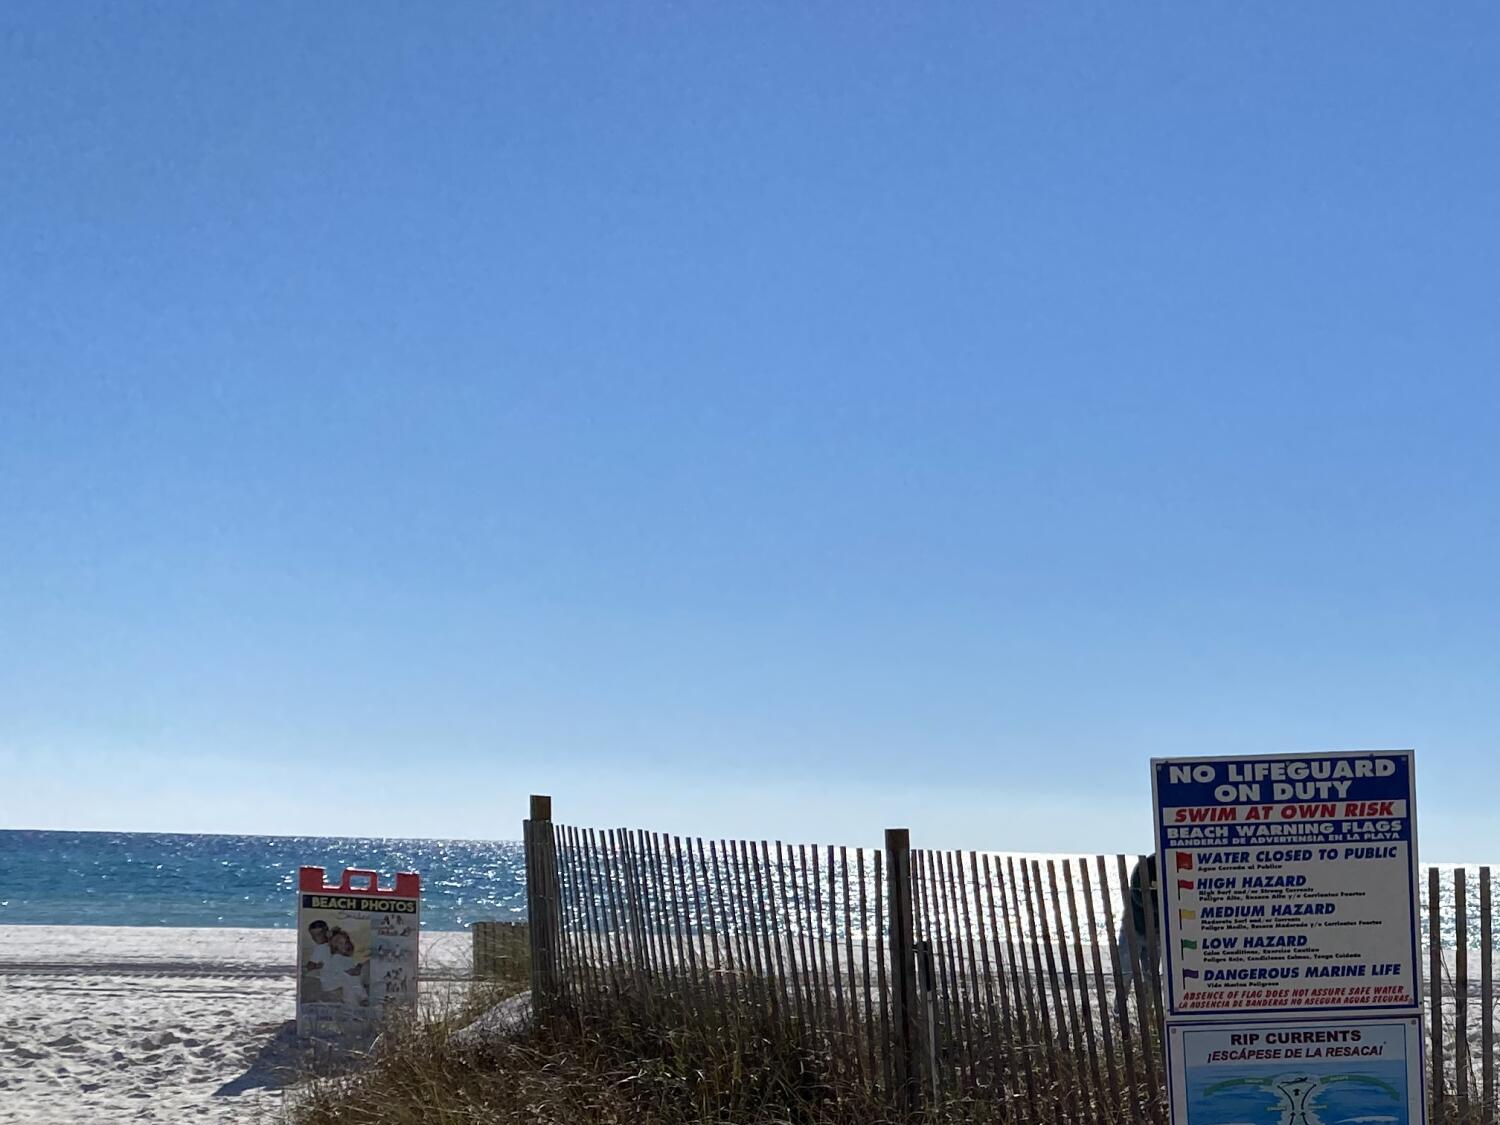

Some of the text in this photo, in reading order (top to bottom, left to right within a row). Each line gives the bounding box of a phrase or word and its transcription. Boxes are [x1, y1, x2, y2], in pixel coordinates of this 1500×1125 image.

[1169, 759, 1396, 784] NO LIFEGUARD
[1214, 780, 1353, 803] ON DUTY
[1174, 802, 1395, 823] SWIM AT OWN RISK
[1167, 820, 1402, 839] BEACH WARNING FLAGS
[1170, 838, 1228, 847] BANDERAS
[1232, 837, 1246, 845] DE
[1346, 833, 1360, 841] LA
[1364, 832, 1400, 840] PLAYA
[1197, 847, 1397, 864] WATER CLOSED TO PUBLIC
[1197, 875, 1307, 890] HIGH HAZARD
[311, 897, 415, 913] BEACH PHOTOS
[1200, 903, 1335, 918] MEDIUM HAZARD
[1202, 935, 1307, 949] LOW HAZARD
[1204, 964, 1401, 981] DANGEROUS MARINE LIFE
[1183, 985, 1404, 1001] ABSENCE OF FLAG DOES NOT ASSURE SAFE WATER
[1178, 1001, 1188, 1009] LA
[1189, 1000, 1230, 1009] AUSENCIA
[1232, 999, 1243, 1008] DE
[1245, 998, 1289, 1007] BANDERAS
[1304, 996, 1341, 1005] ASEGURA
[1343, 995, 1371, 1004] AGUAS
[1231, 1030, 1362, 1046] RIP CURRENTS
[1284, 1048, 1302, 1059] DE
[1305, 1047, 1322, 1058] LA
